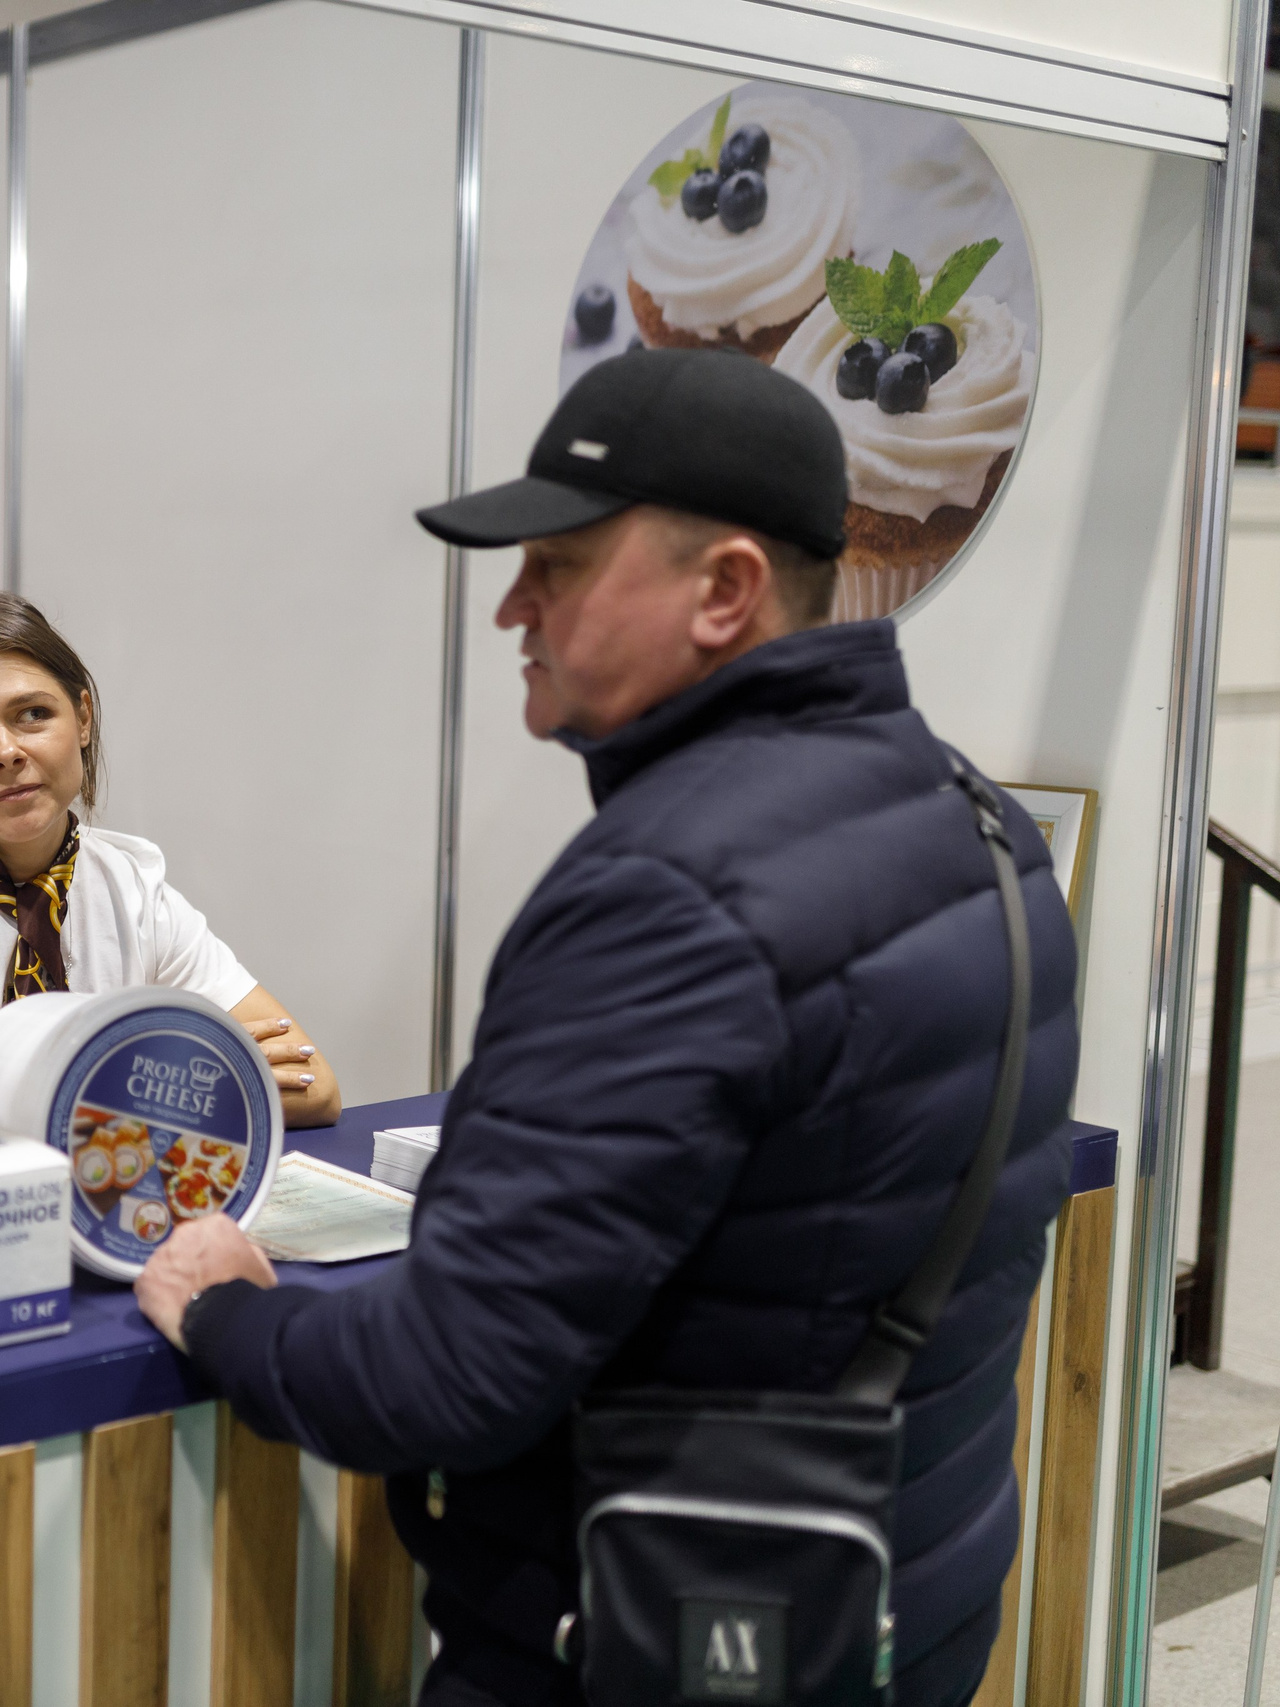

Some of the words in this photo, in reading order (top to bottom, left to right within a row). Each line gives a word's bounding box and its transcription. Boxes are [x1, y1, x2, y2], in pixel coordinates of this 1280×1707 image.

[131, 1054, 189, 1087] PROFI
[126, 1074, 216, 1118] CHEESE
[11, 1301, 32, 1323] 10
